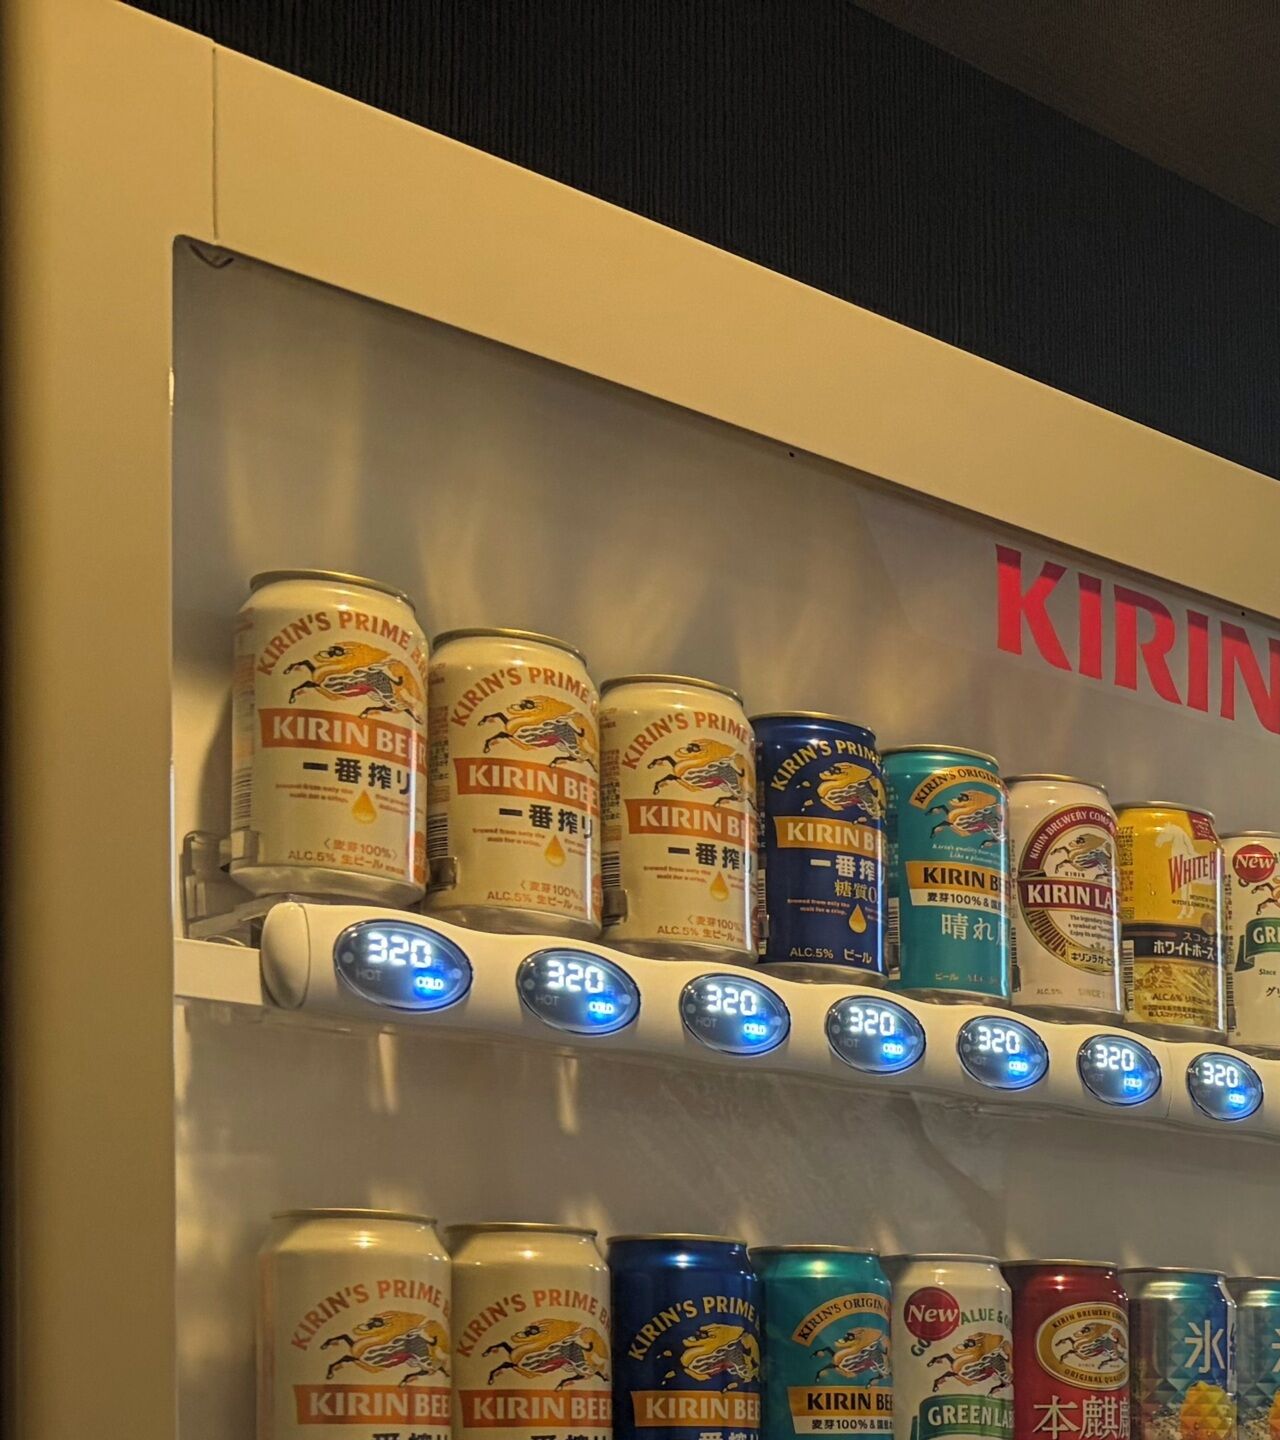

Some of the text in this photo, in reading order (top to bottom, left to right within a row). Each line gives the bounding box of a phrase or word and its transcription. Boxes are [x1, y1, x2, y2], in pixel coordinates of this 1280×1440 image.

[257, 611, 411, 677] KIRIN'S PRIME
[452, 666, 590, 728] KIRIN'S PRIME
[272, 714, 369, 748] KIRIN
[622, 711, 750, 770] KIRIN'S PRIME
[302, 756, 413, 796] 一番搾り
[469, 764, 559, 796] KIRIN
[770, 739, 833, 793] KIRIN'S
[499, 804, 593, 840] 一番搾り
[639, 805, 722, 834] KIRIN
[787, 825, 860, 850] KIRIN
[922, 866, 987, 888] KIRIN
[1235, 855, 1277, 873] New
[1026, 884, 1091, 907] KIRIN
[369, 934, 432, 969] 320
[547, 961, 604, 994] 320
[707, 984, 759, 1015] 320
[849, 1011, 895, 1038] 320
[977, 1027, 1020, 1054] 320
[1096, 1046, 1135, 1072] 320
[1202, 1063, 1240, 1088] 320
[291, 1279, 442, 1350] KIRIN'S PRIME
[456, 1288, 597, 1358] KIRIN'S PRIME
[627, 1295, 757, 1361] KIRIN'S PRIME
[799, 1305, 843, 1341] KIRIN'S
[907, 1303, 959, 1325] New
[309, 1392, 408, 1418] KIRIN
[473, 1395, 566, 1420] KIRIN
[645, 1397, 730, 1420] KIRIN
[807, 1391, 873, 1412] KIRIN
[927, 1404, 1001, 1429] GREEN
